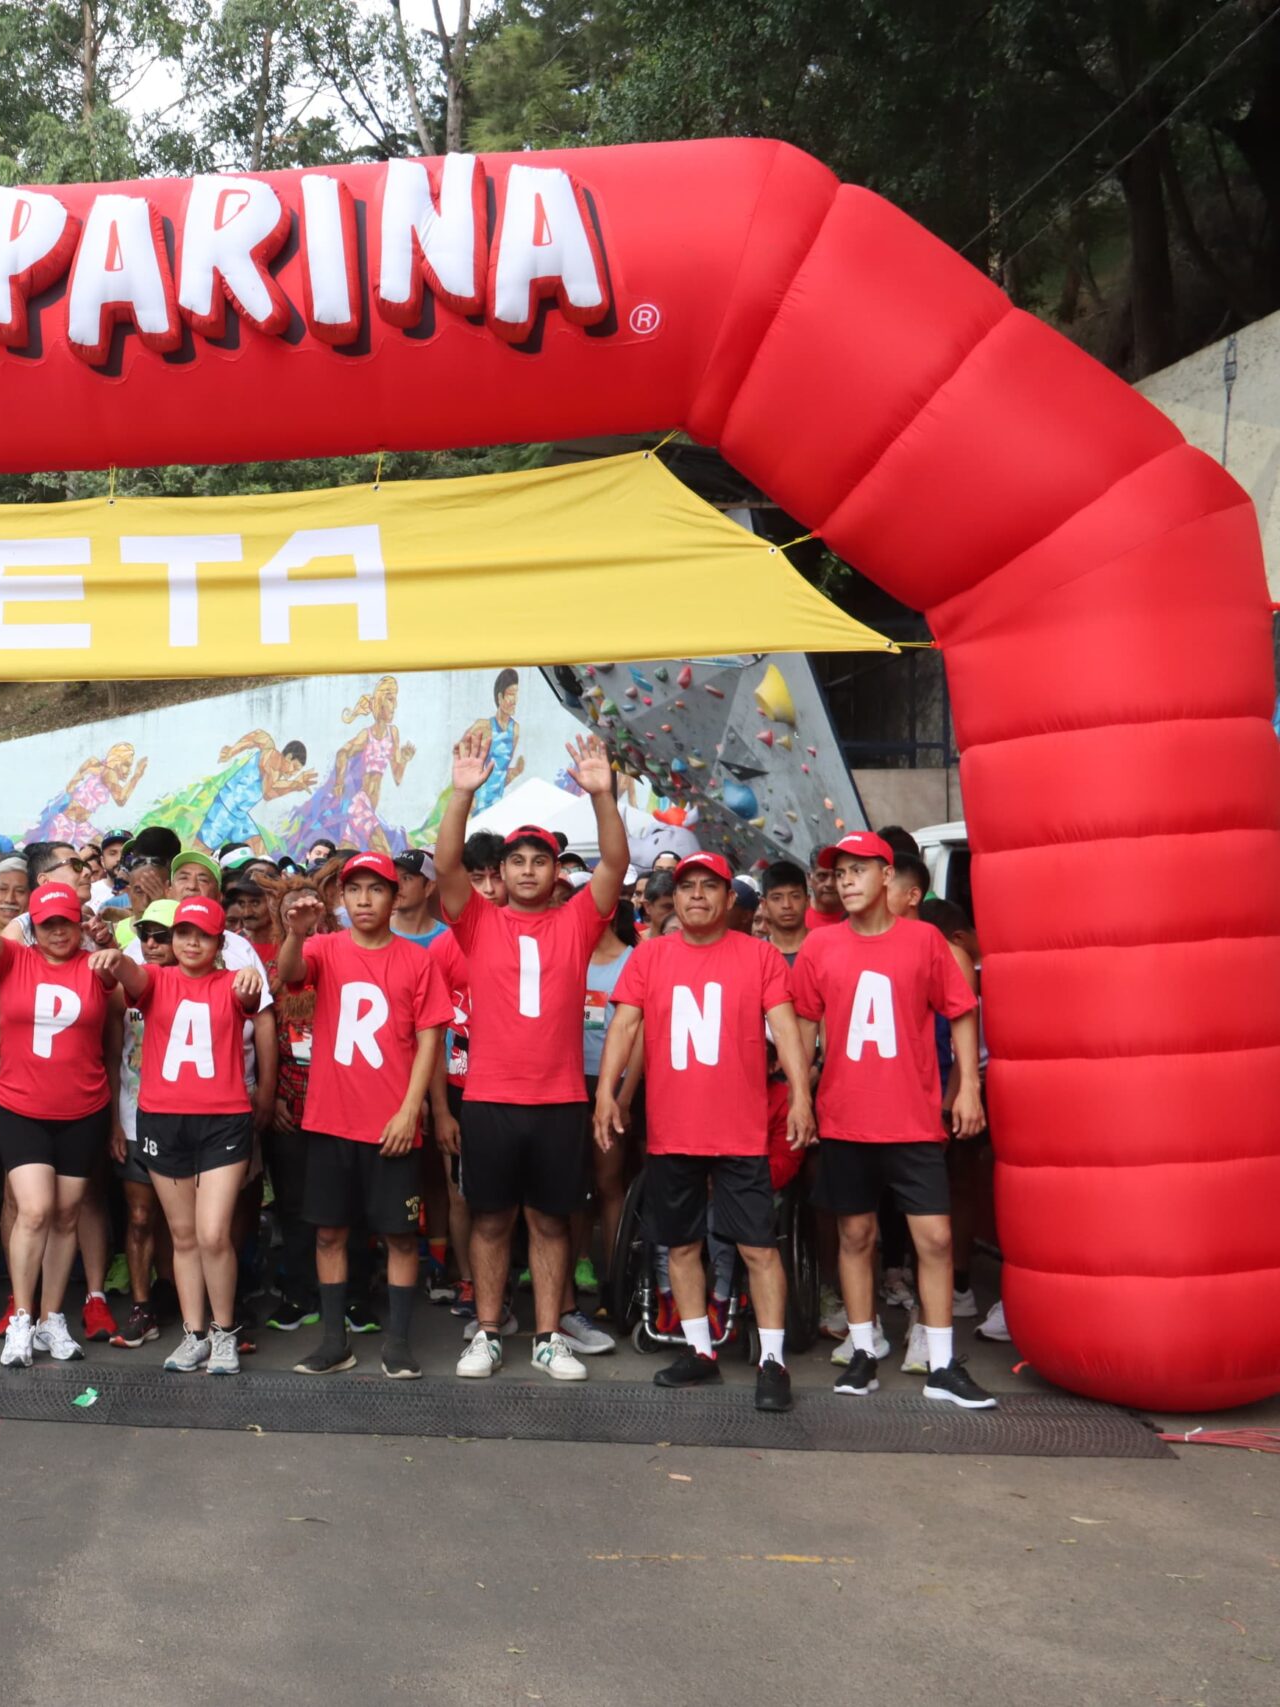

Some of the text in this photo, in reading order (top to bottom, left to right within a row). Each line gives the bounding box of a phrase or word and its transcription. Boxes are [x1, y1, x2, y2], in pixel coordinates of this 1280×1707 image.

[518, 935, 541, 1018] I
[846, 970, 897, 1062] A
[32, 982, 82, 1059] P
[161, 999, 215, 1082] A
[333, 981, 389, 1069] R
[670, 981, 723, 1071] N
[142, 1136, 159, 1157] 18
